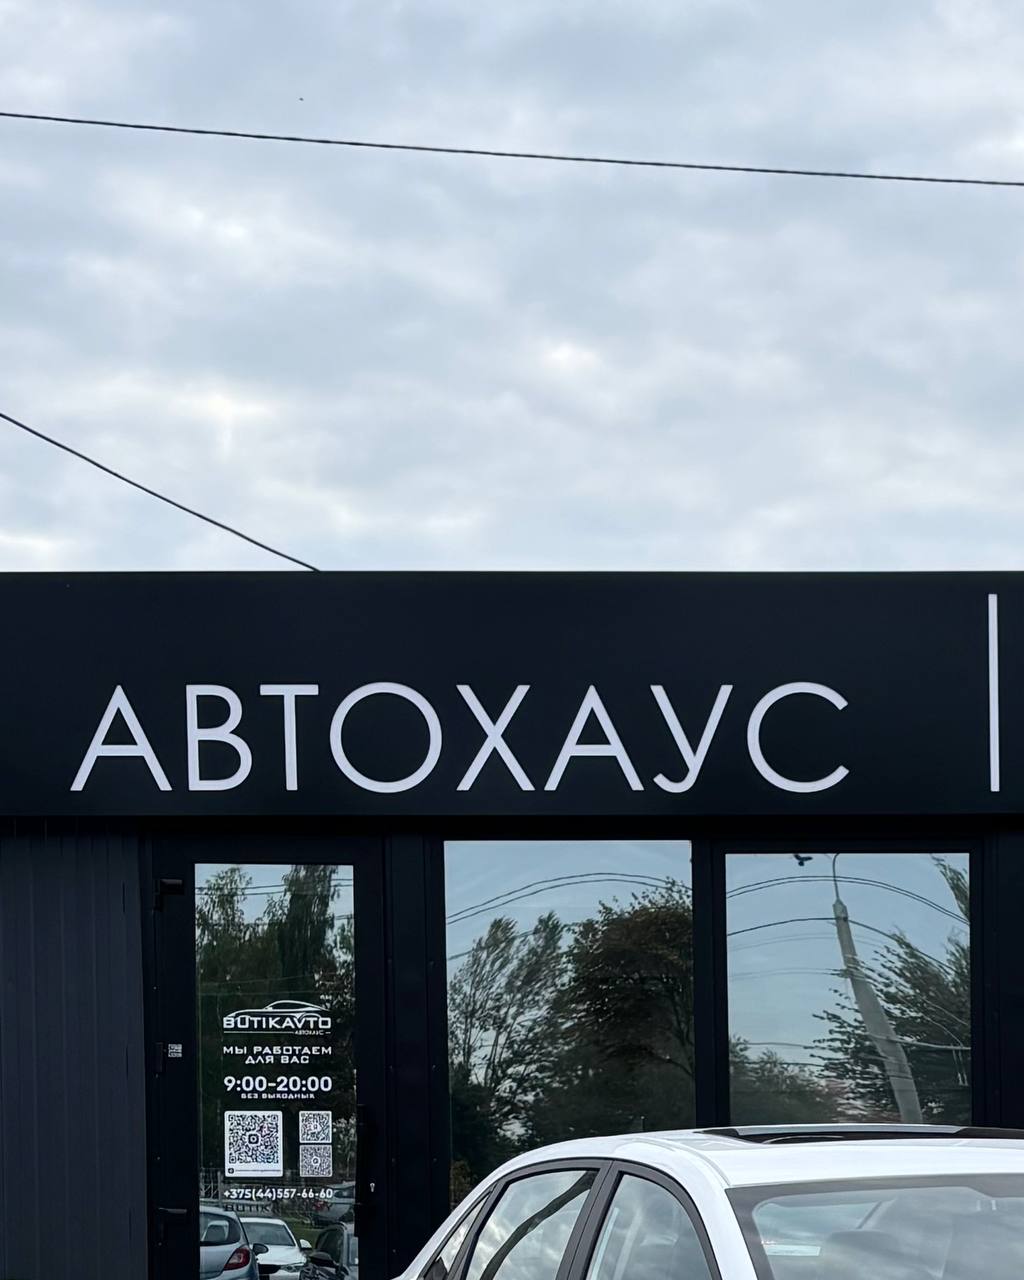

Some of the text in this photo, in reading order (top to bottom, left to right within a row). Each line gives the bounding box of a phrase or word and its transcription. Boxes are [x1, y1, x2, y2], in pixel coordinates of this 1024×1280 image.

[70, 681, 849, 794] АВТОХАУС
[223, 1016, 332, 1029] BUTIKAVTO
[223, 1046, 332, 1055] МЫ РАБОТАЕМ
[245, 1055, 310, 1064] ДЛЯ ВАС
[223, 1076, 333, 1092] 9:00-20:00
[223, 1188, 334, 1200] +375(44)557-66-60
